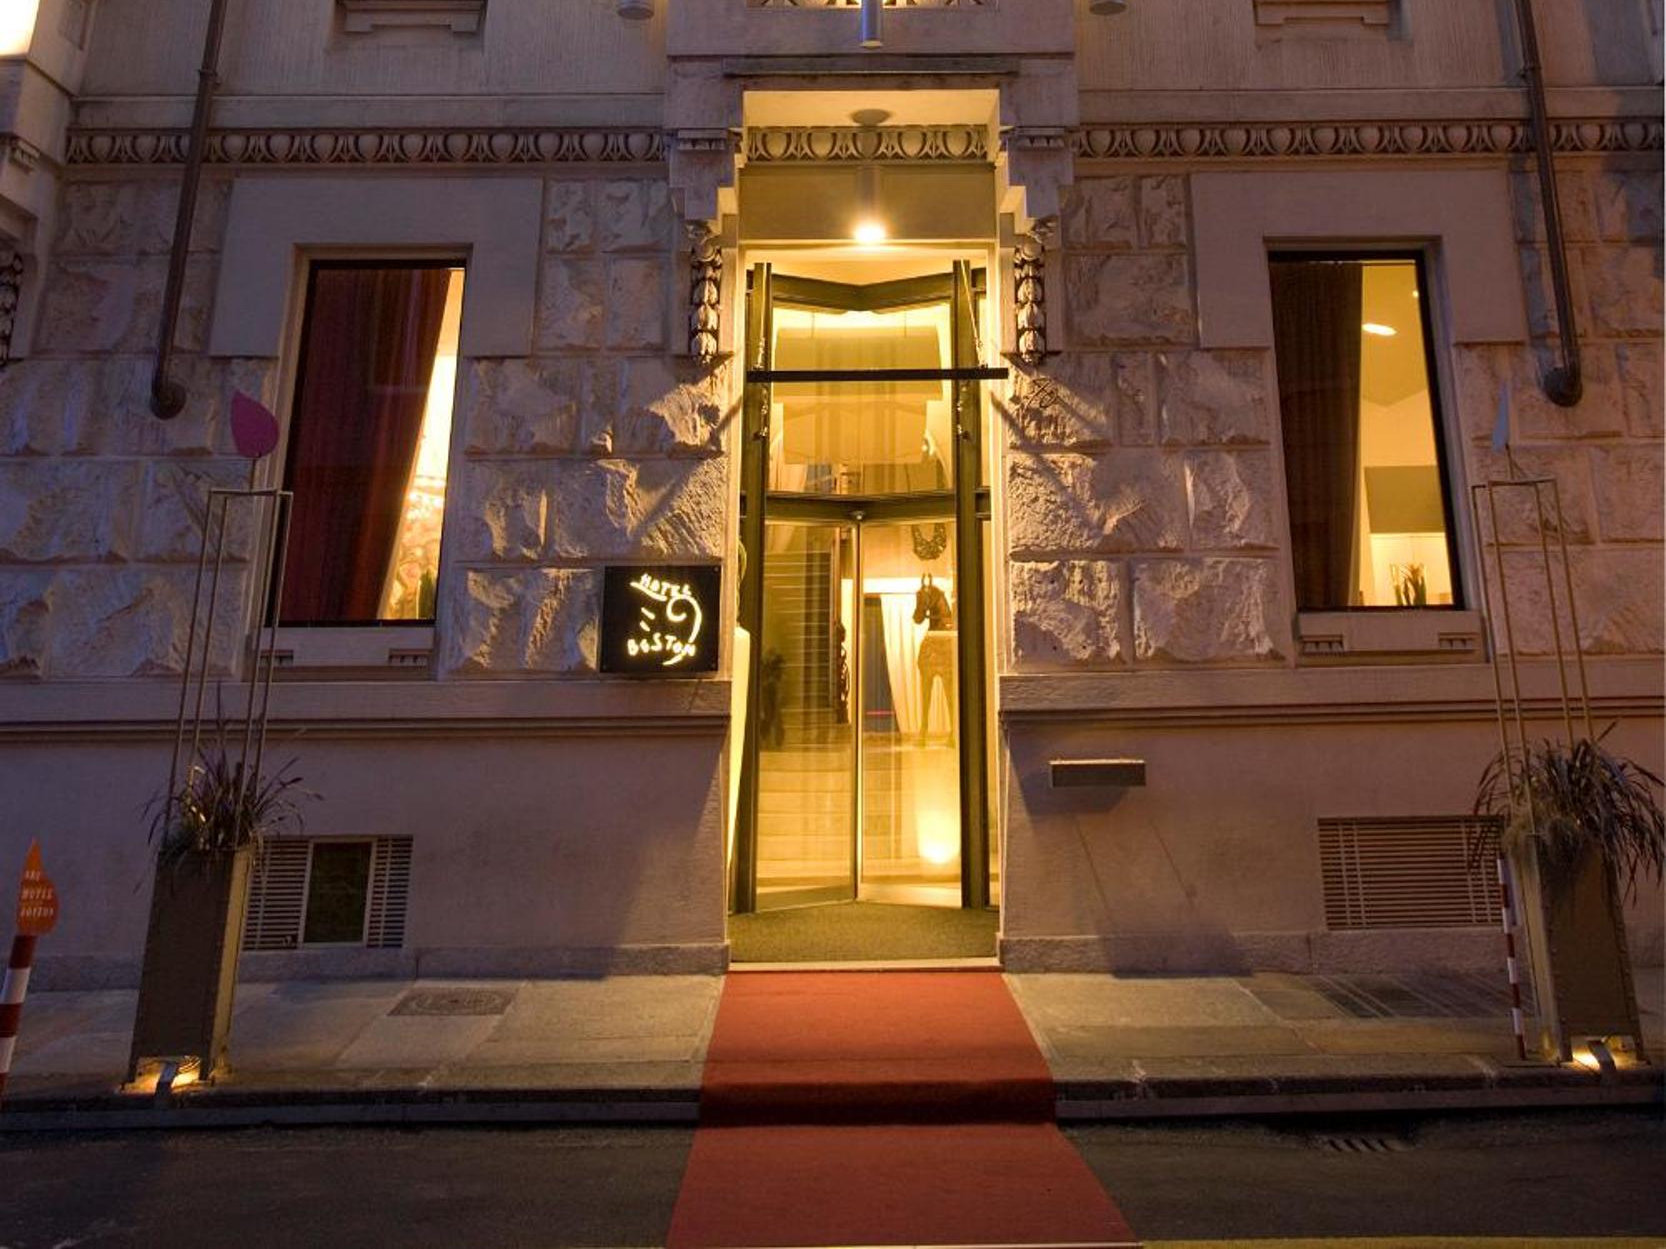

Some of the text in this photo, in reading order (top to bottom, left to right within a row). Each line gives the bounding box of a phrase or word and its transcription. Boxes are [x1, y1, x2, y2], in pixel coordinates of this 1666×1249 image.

[640, 573, 692, 597] HOTEL
[627, 633, 697, 657] BOSTON
[21, 886, 53, 900] HOTEL
